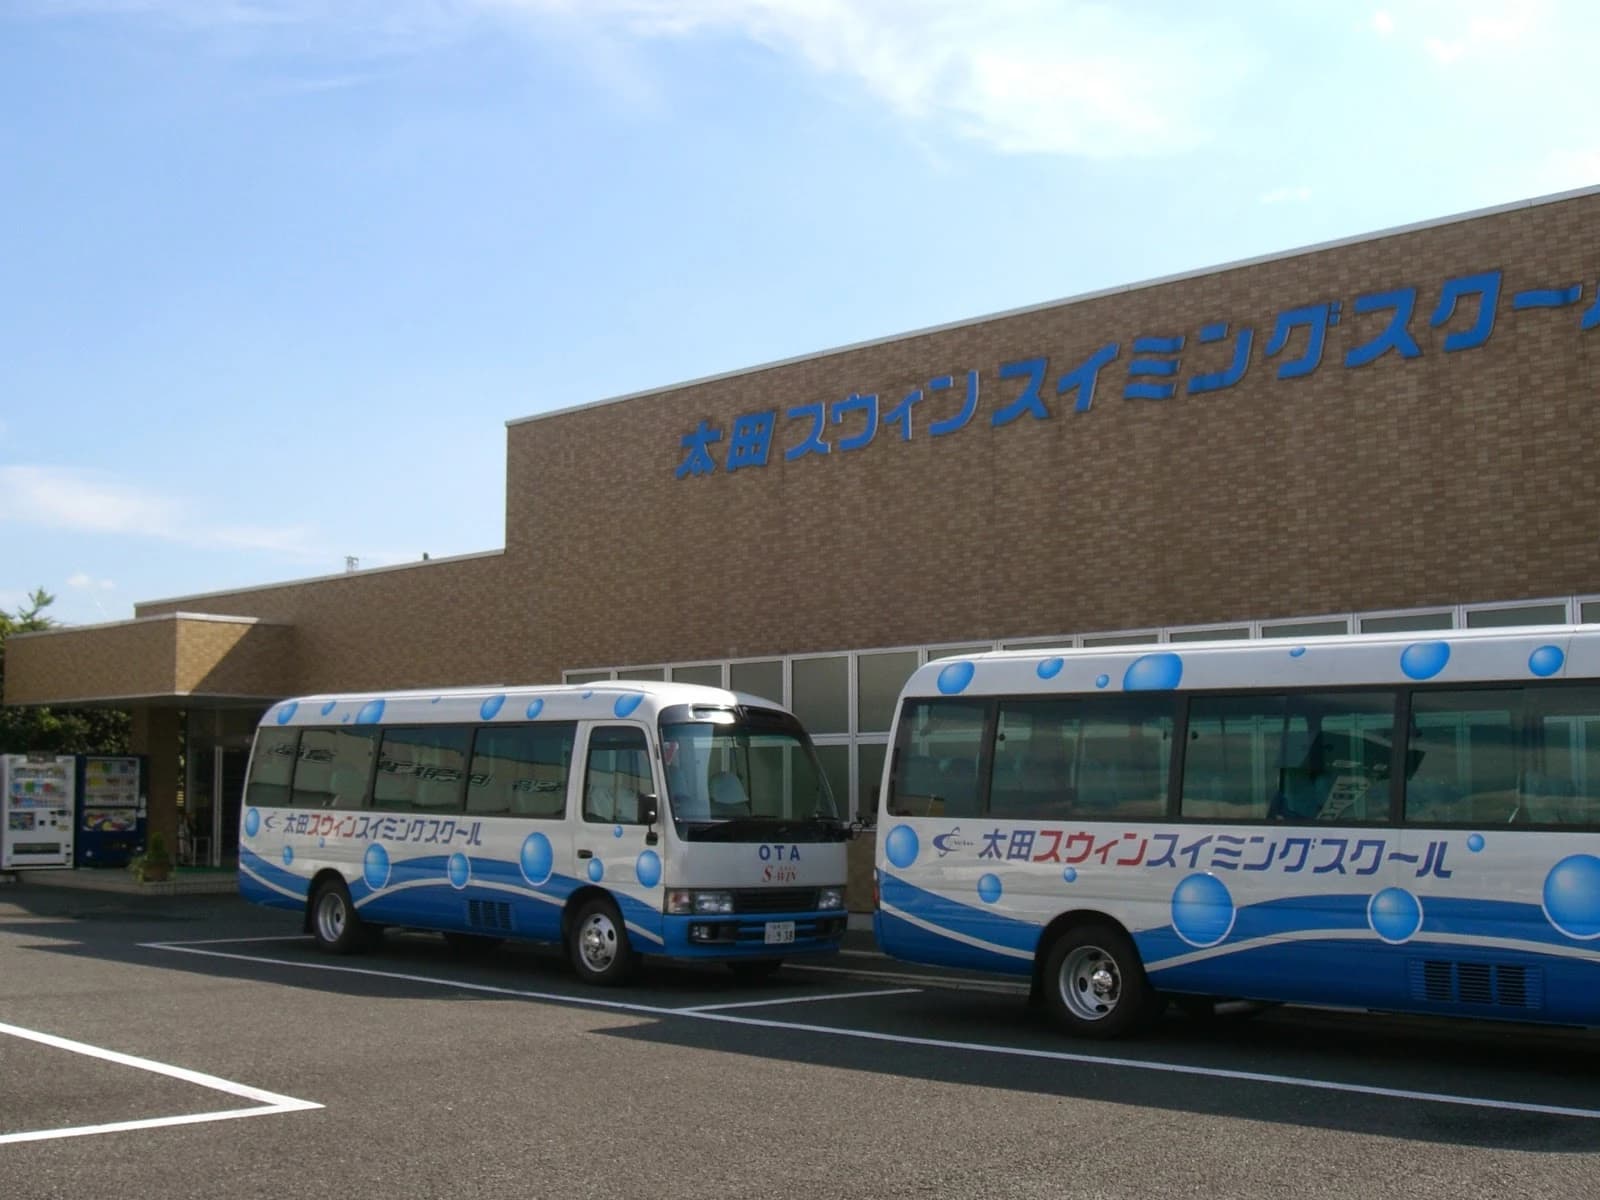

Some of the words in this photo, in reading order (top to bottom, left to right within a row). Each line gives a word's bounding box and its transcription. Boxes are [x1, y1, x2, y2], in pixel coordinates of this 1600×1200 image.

[759, 845, 800, 861] OTA
[978, 827, 1453, 879] 太田スウィンスイミングスクール
